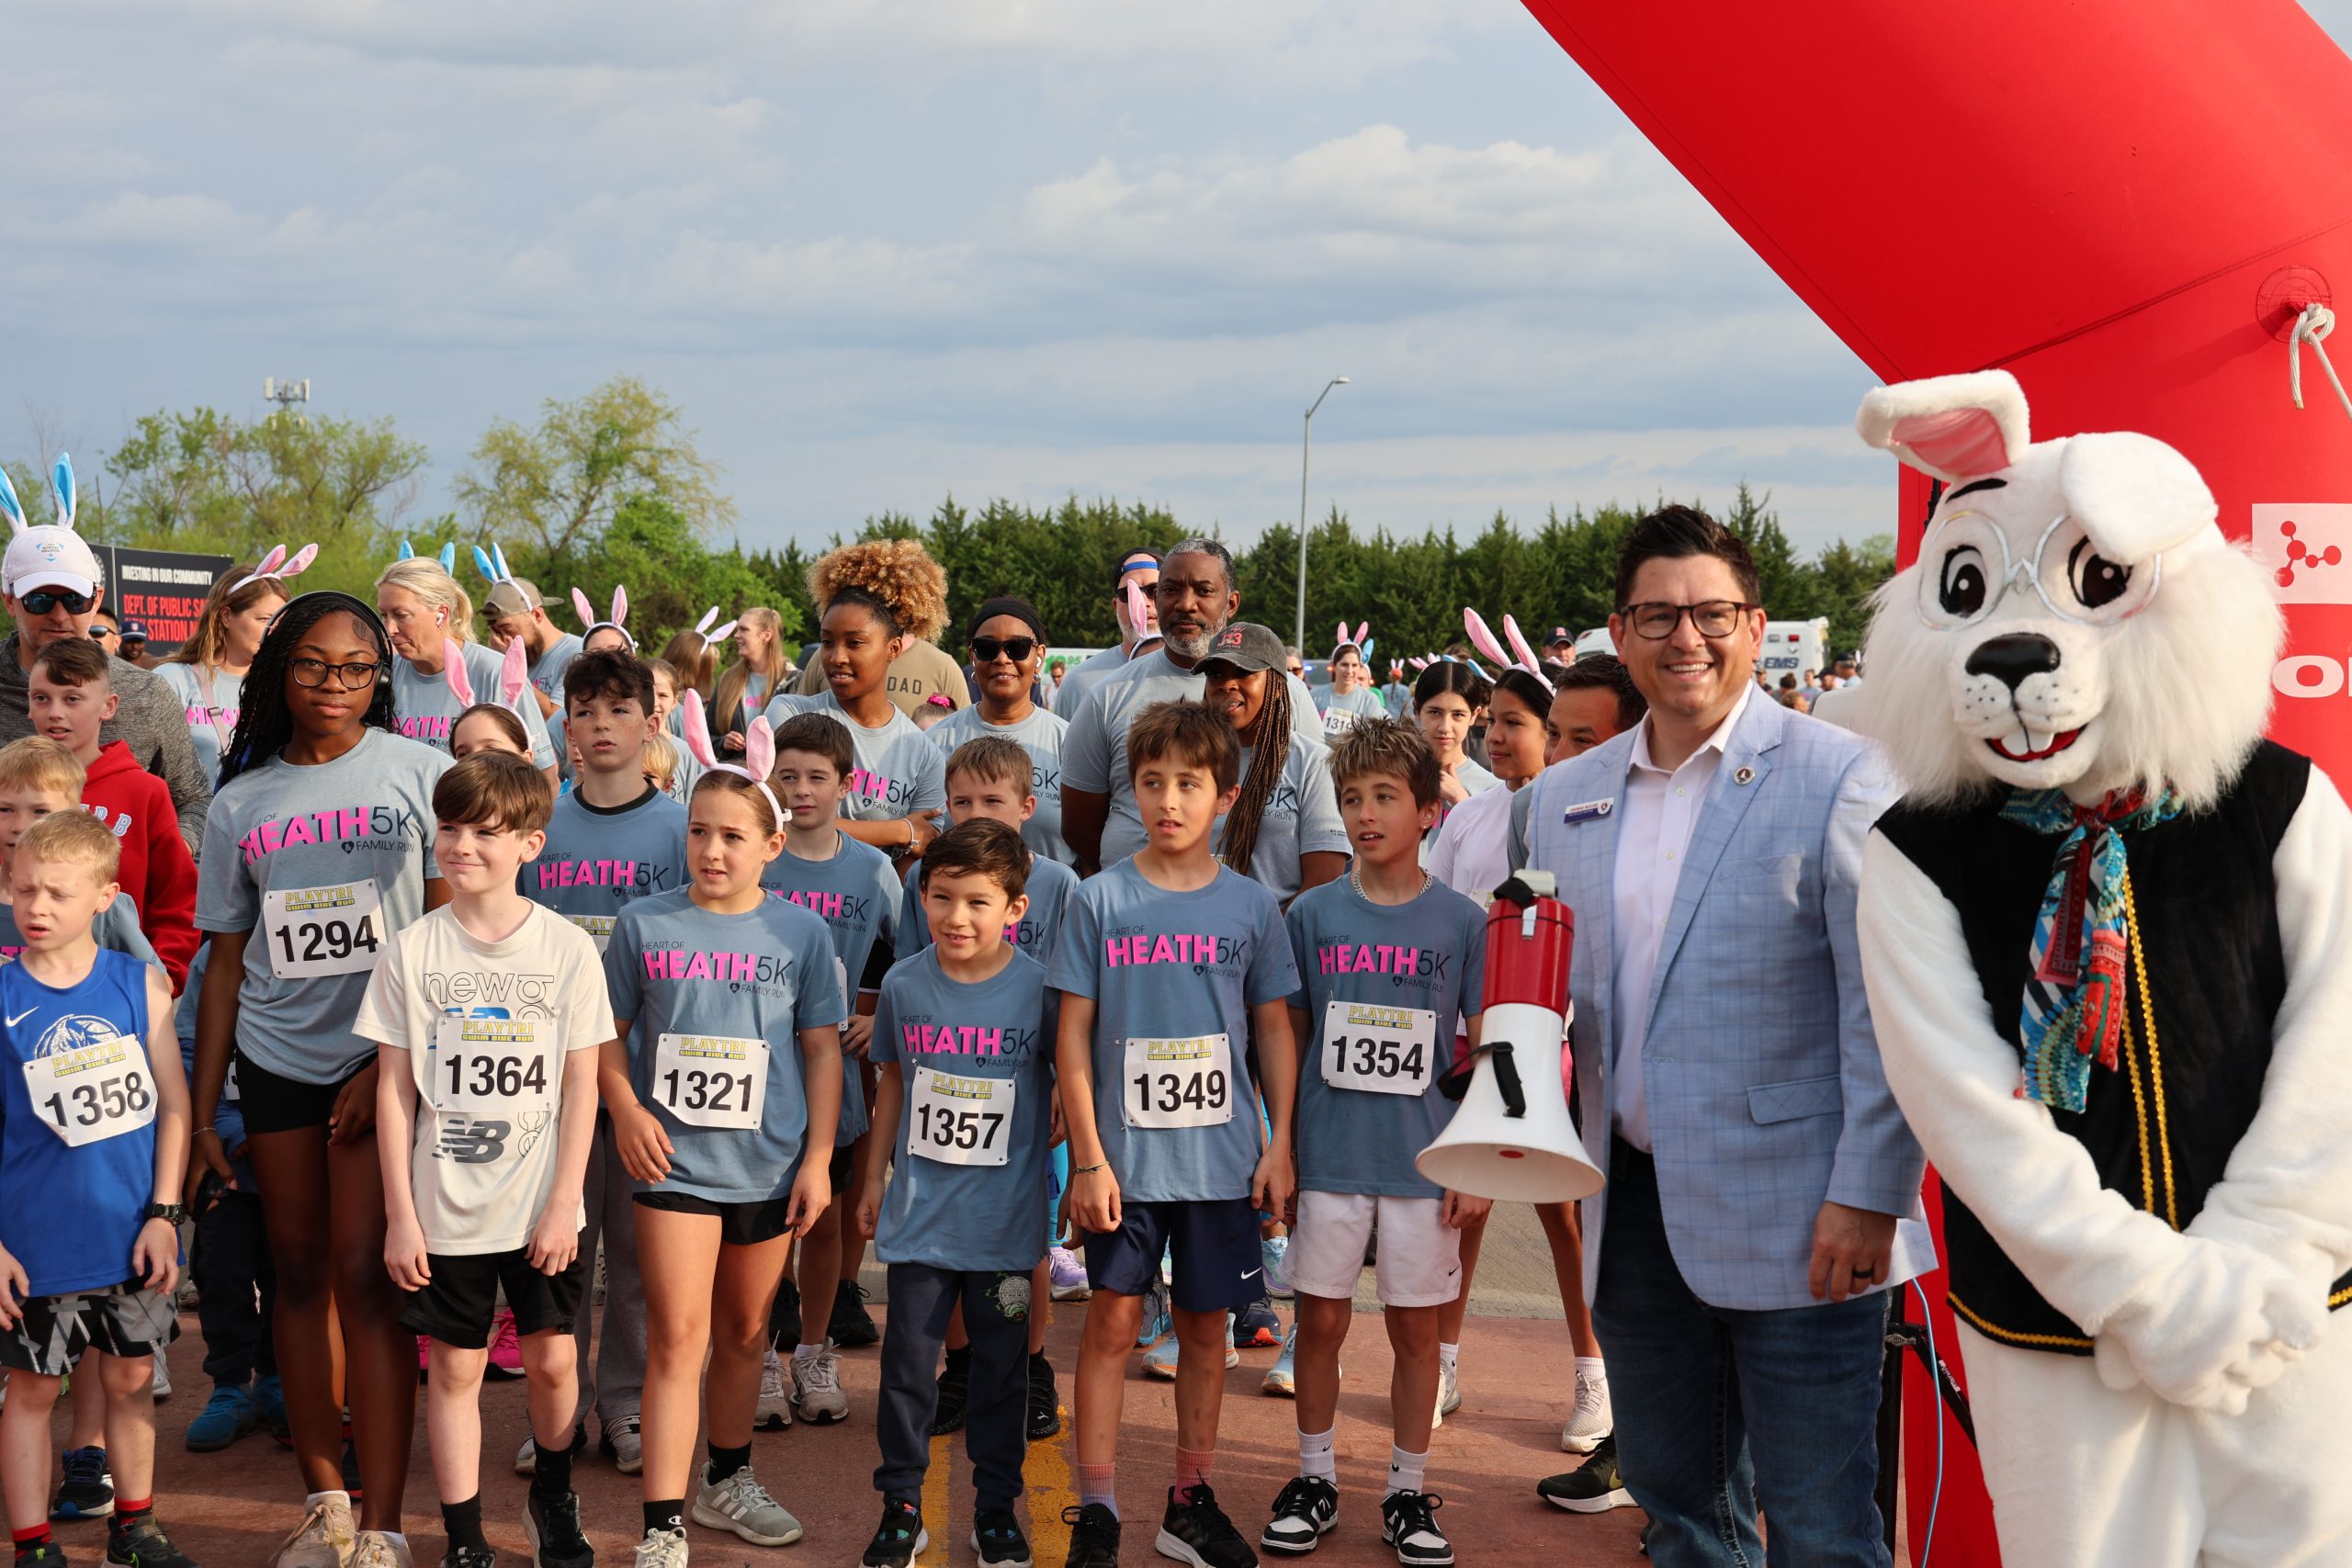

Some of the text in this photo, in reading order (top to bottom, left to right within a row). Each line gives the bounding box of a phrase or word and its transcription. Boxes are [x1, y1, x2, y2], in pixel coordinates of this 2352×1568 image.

[121, 565, 152, 581] INVESTING
[153, 568, 159, 582] IN
[160, 569, 173, 583] OUR
[174, 569, 212, 585] COMMUNITY
[123, 594, 146, 615] DEPT.
[147, 596, 158, 615] OF
[160, 597, 191, 617] PUBLIC
[148, 620, 187, 641] STATION
[1765, 658, 1799, 669] EMS
[2271, 655, 2352, 698] O
[888, 676, 922, 695] DAD
[1275, 812, 1292, 820] RUN
[356, 840, 395, 851] FAMILY
[397, 842, 414, 853] RUN
[537, 853, 560, 863] HEART
[285, 886, 354, 904] PLAYTRI
[853, 924, 866, 932] RUN
[1105, 925, 1146, 937] HEART OF
[276, 915, 378, 963] 1294
[641, 942, 669, 950] HEART
[1316, 934, 1351, 946] HEART OF
[424, 972, 514, 1003] new
[741, 985, 770, 996] FAMILY
[771, 989, 786, 998] RUN
[1404, 978, 1430, 989] FAMILY
[899, 1015, 933, 1024] HEART OF
[1349, 1006, 1412, 1022] PLAYTRI
[462, 1021, 534, 1034] PLAYTRI
[681, 1037, 746, 1052] PLAYTRI
[1148, 1039, 1211, 1053] PLAYTRI
[52, 1042, 124, 1070] PLAYTRI
[988, 1058, 1016, 1067] FAMILY
[1332, 1035, 1424, 1080] 1354
[446, 1054, 547, 1096] 1364
[933, 1073, 994, 1092] PLAYTRI
[664, 1069, 752, 1111] 1321
[1134, 1069, 1226, 1112] 1349
[45, 1071, 151, 1128] 1358
[919, 1103, 1004, 1149] 1357
